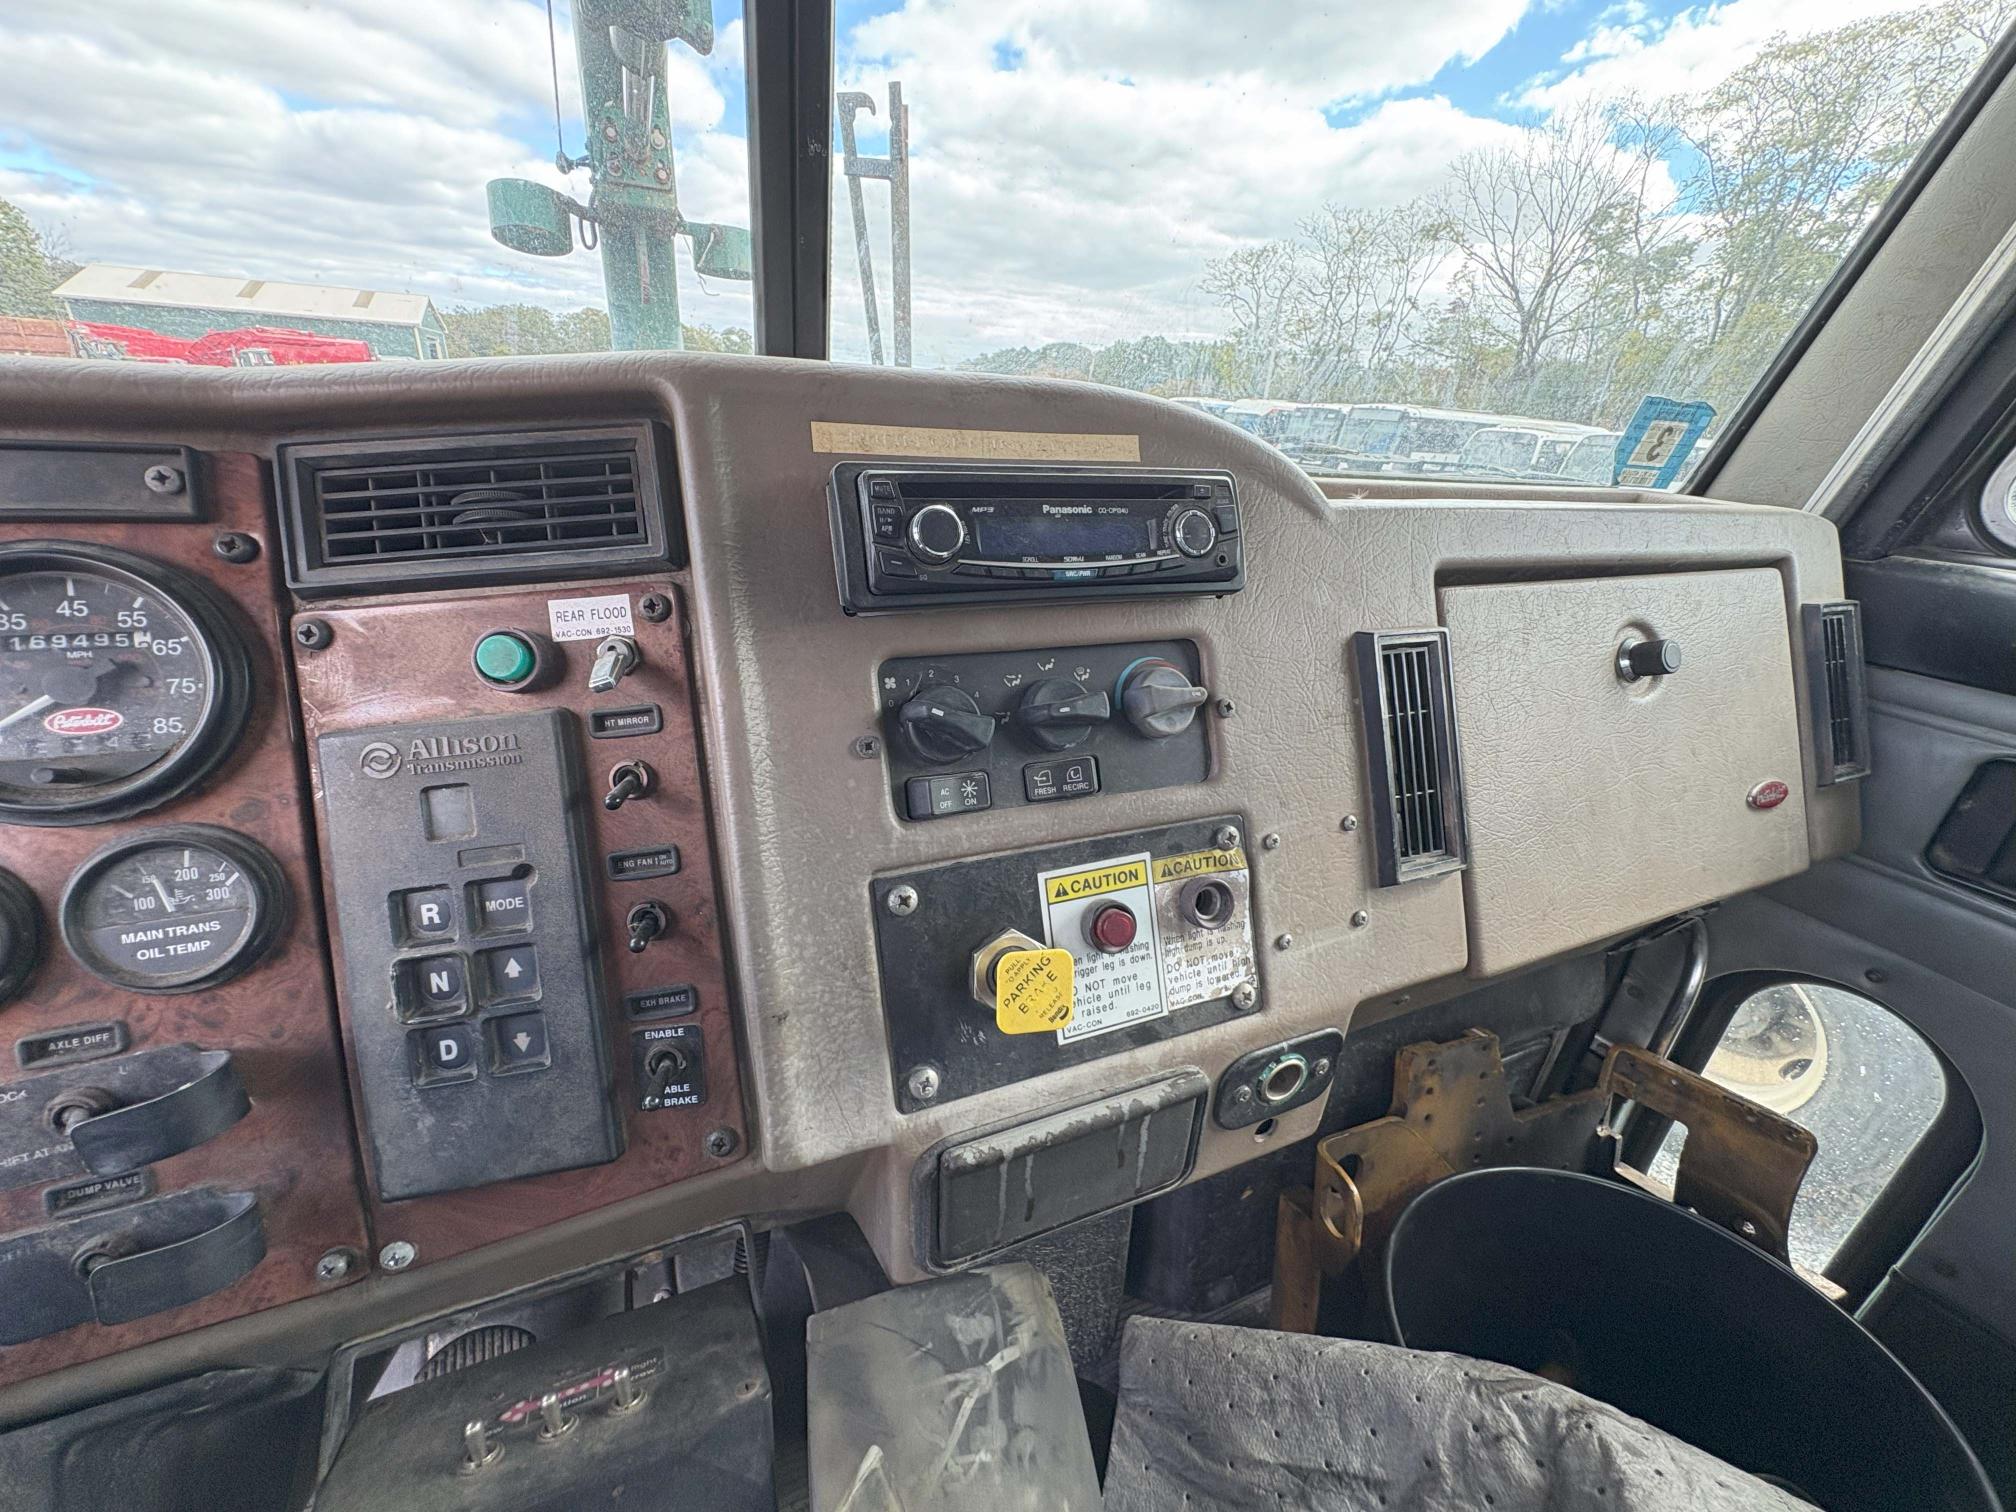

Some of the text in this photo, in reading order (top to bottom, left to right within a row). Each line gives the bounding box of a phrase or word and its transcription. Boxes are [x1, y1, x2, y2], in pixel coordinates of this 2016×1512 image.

[1042, 504, 1093, 514] Panasonic
[56, 600, 88, 617] 45
[556, 606, 627, 623] REAR FLOOD
[117, 611, 147, 628] 55
[555, 628, 593, 639] VAC-CON
[66, 650, 93, 659] MPH
[152, 638, 183, 656] 65
[928, 669, 935, 678] 2
[954, 675, 960, 683] 3
[166, 678, 196, 694] 75
[153, 716, 183, 734] 85
[617, 716, 650, 727] MIRROR
[405, 733, 521, 761] Allison
[407, 752, 523, 775] Transmission
[940, 788, 950, 797] AC
[1034, 786, 1057, 796] FRESH
[1062, 782, 1090, 792] RECIRC
[939, 801, 952, 809] OFF
[964, 798, 977, 806] ON
[637, 857, 653, 867] FAN
[1173, 851, 1240, 875] CAUTION
[174, 867, 199, 882] 200
[209, 872, 226, 883] 250
[1070, 868, 1140, 894] CAUTION
[206, 887, 230, 901] 300
[134, 896, 156, 911] 100
[485, 896, 525, 912] MODE
[420, 903, 441, 925] R
[121, 920, 222, 944] MAIN TRANS
[136, 940, 211, 961] OIL TEMP
[1184, 941, 1203, 953] dump
[1206, 938, 1213, 947] is
[1074, 953, 1153, 979] rigger leg is down.
[1166, 950, 1234, 974] DO NOT move
[1168, 969, 1202, 984] vehicle
[1207, 960, 1227, 974] until
[429, 970, 449, 994] N
[1003, 955, 1051, 1008] PARKING
[1084, 979, 1106, 993] NOT
[1112, 973, 1138, 986] move
[1169, 983, 1192, 996] dump
[1196, 980, 1203, 989] is
[1108, 984, 1130, 999] until
[1136, 981, 1152, 991] leg
[640, 994, 687, 1008] EXH BRAKE
[1081, 1001, 1118, 1017] raised.
[644, 1028, 685, 1040] ENABLE
[1066, 1018, 1103, 1034] VAC-CON
[48, 1032, 111, 1051] AXLE DIFF
[439, 1039, 458, 1061] D
[664, 1083, 690, 1095] ABLE
[664, 1095, 698, 1107] BRAKE
[67, 1175, 141, 1199] DUMP VALVE
